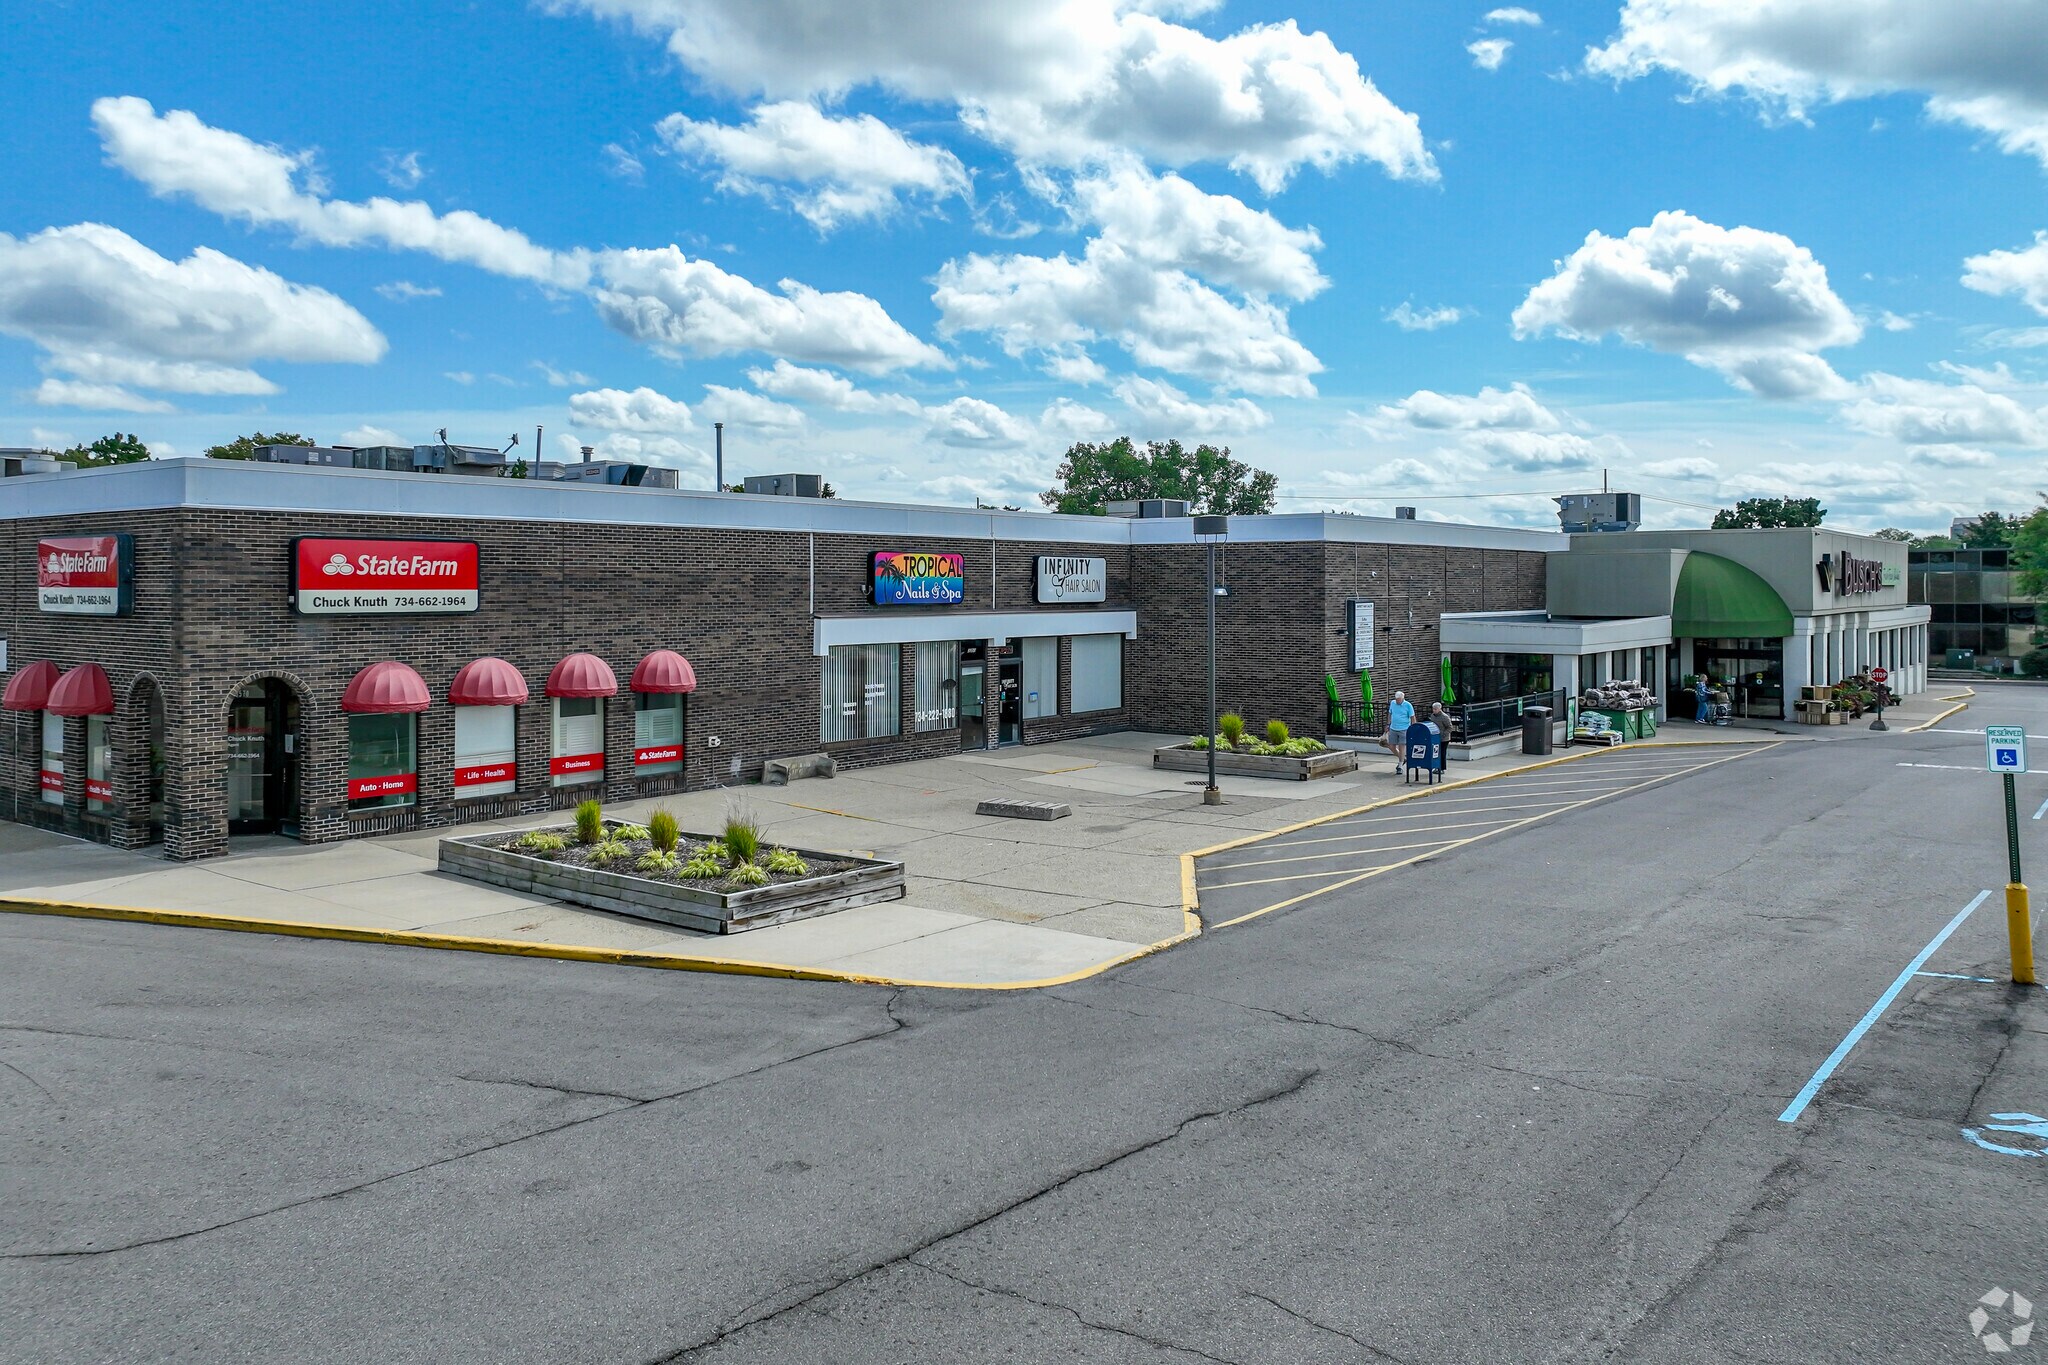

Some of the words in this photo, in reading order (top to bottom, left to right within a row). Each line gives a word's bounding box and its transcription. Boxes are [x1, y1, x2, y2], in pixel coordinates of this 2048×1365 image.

[903, 556, 962, 577] TROPICAL
[1044, 558, 1090, 575] INFINITY
[895, 576, 930, 599] Nails
[940, 580, 962, 602] Spa
[1065, 579, 1079, 592] HAIR
[1081, 579, 1100, 592] SALON
[43, 594, 58, 605] Chuck
[60, 594, 74, 605] Knuth
[76, 595, 112, 605] 734-662-1964
[312, 596, 350, 607] Chuck
[354, 596, 388, 607] Knuth
[394, 596, 467, 606] 734-662-1964
[1871, 671, 1887, 679] STOP
[1988, 729, 2022, 737] RESERVED
[1991, 737, 2021, 745] PARKING
[565, 760, 591, 769] Business
[467, 771, 480, 780] Life
[484, 768, 506, 778] Health
[359, 784, 377, 793] Auto
[382, 779, 404, 790] Home
